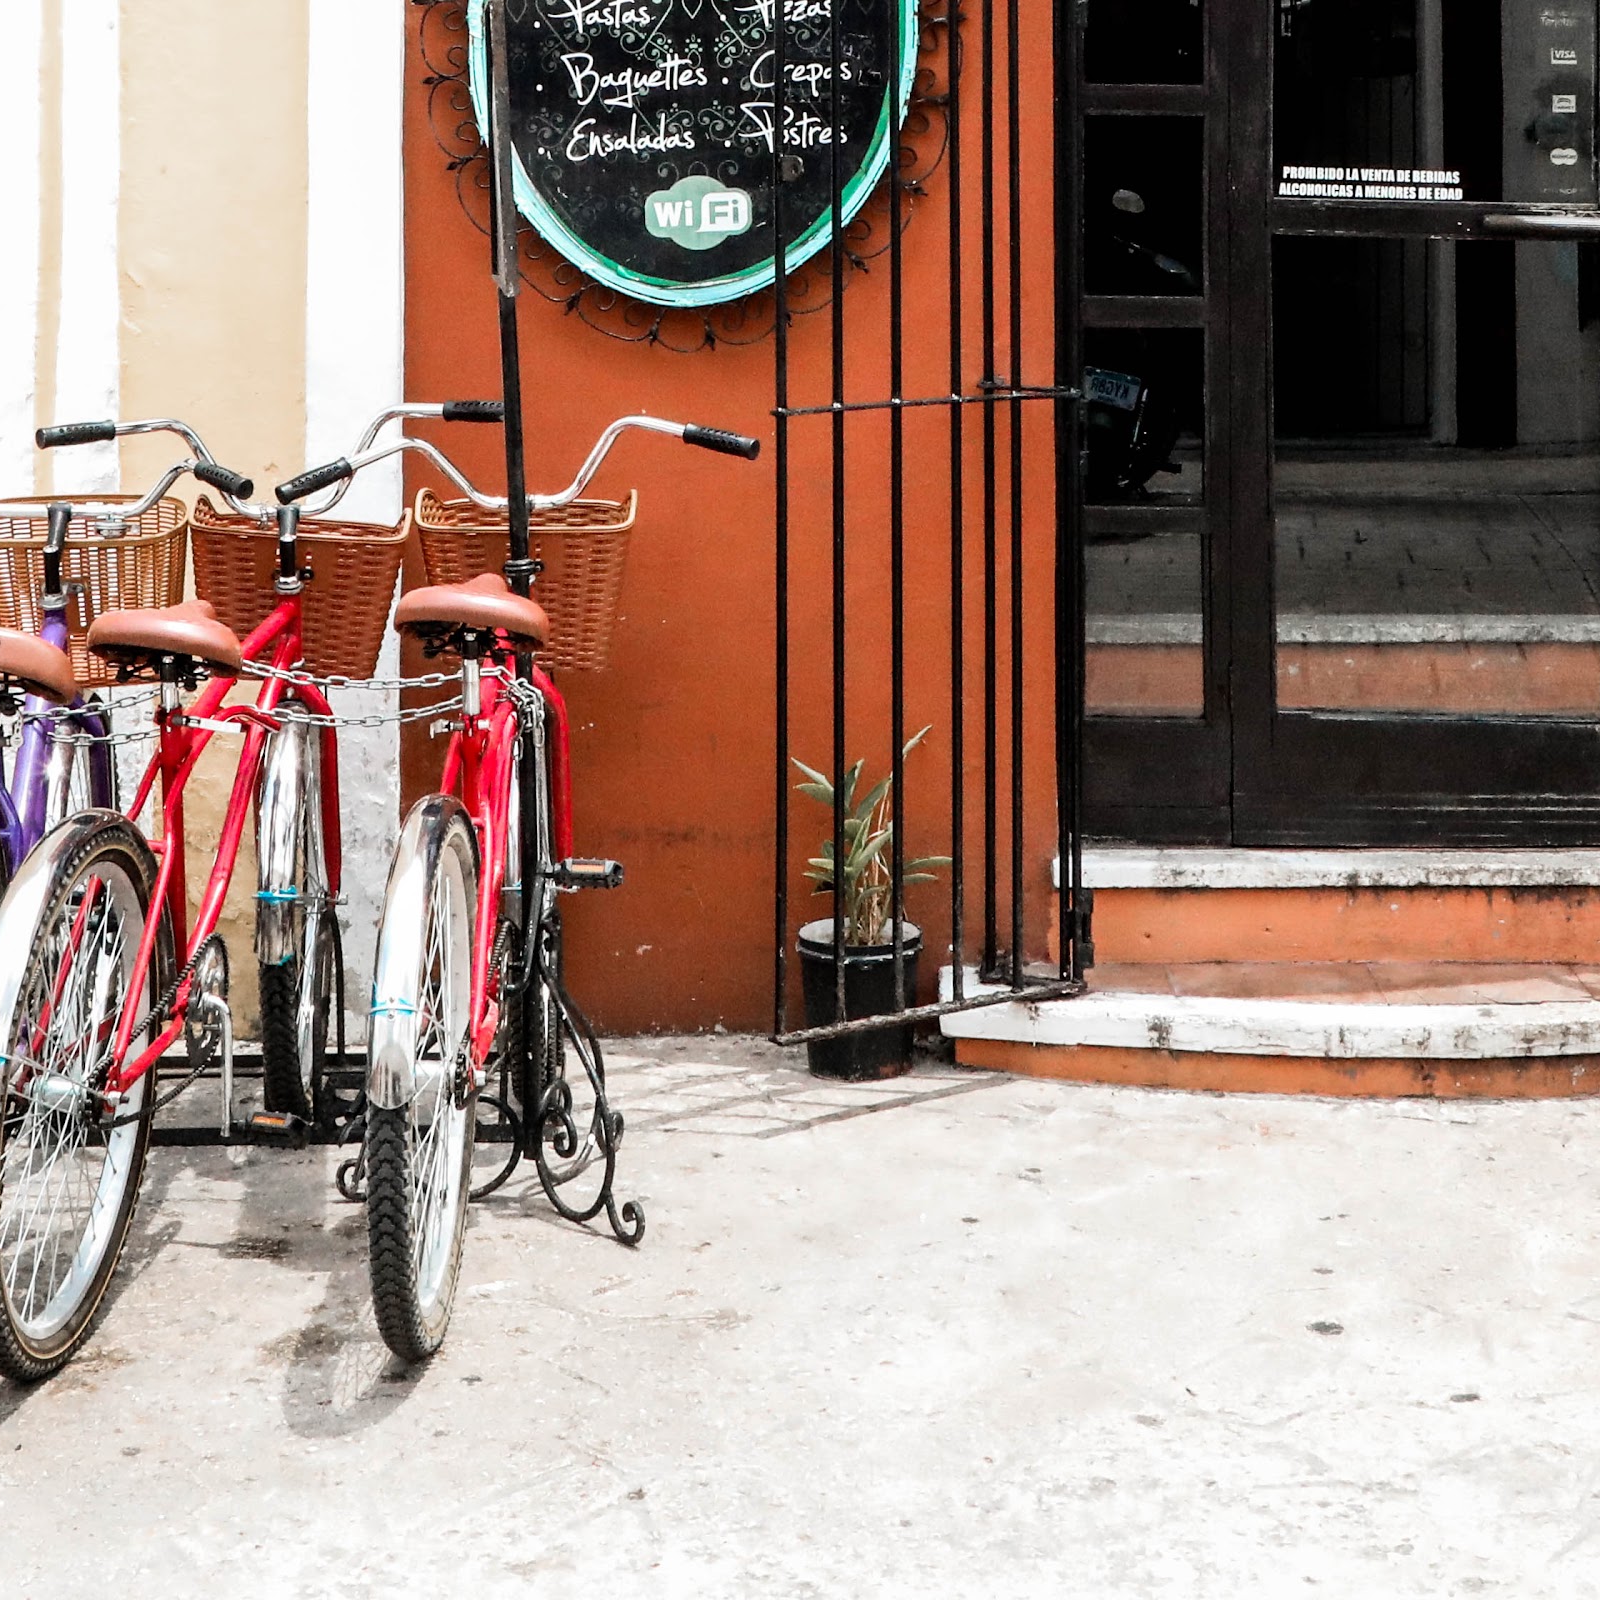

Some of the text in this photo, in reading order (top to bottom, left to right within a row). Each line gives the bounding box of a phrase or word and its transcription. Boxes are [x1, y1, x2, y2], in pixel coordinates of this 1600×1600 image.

[1554, 50, 1576, 59] VISA
[561, 53, 707, 108] Baguettes
[566, 113, 696, 162] Ensaladas
[1282, 166, 1461, 184] PROHIBIDO LA VENTA DE BEBIDAS
[1279, 182, 1463, 201] ALCOHOLICAS A MENORES DE EDAD
